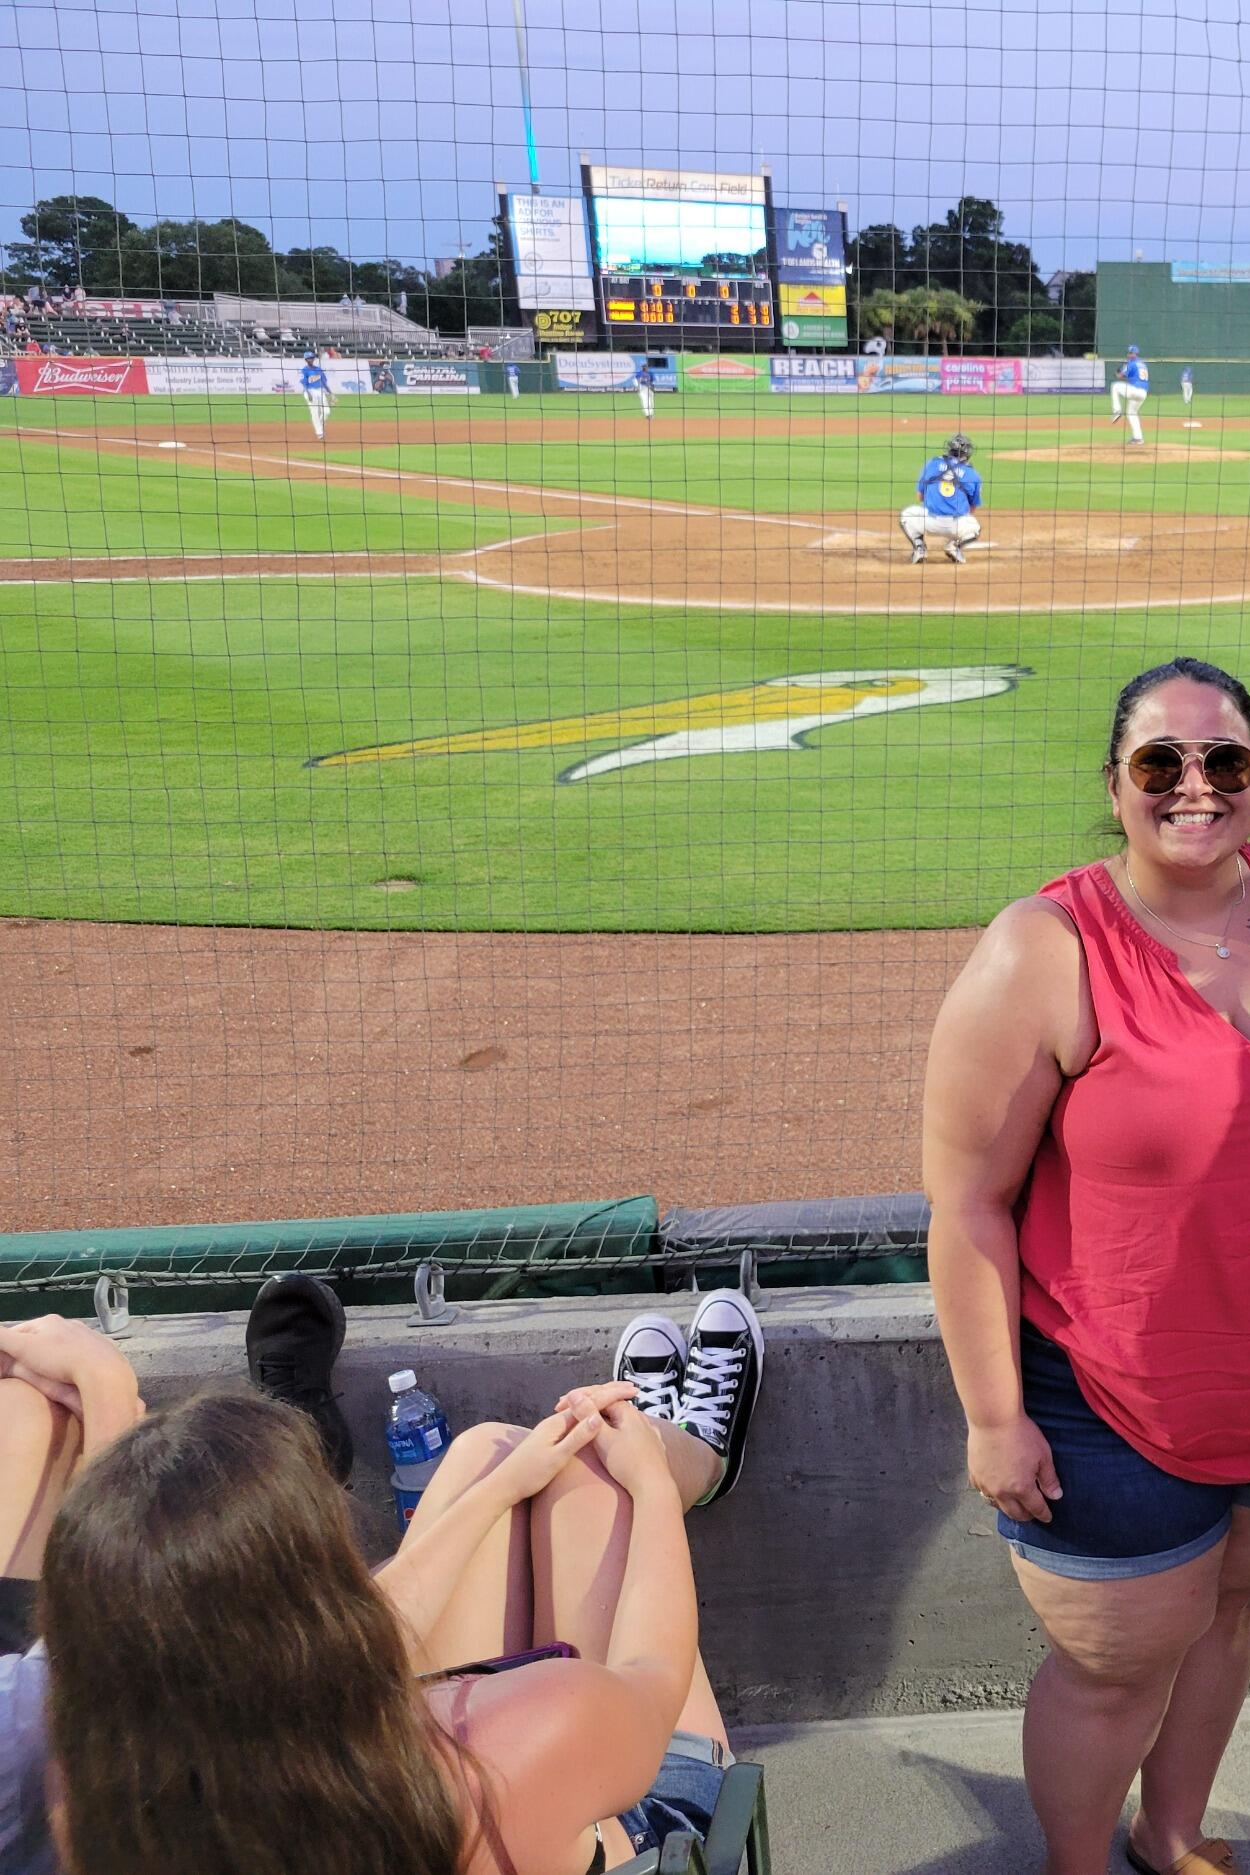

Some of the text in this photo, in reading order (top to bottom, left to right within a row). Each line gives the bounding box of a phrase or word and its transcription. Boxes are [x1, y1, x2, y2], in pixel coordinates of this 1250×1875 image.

[549, 311, 582, 323] 707
[558, 358, 633, 372] DocuSystems
[773, 358, 855, 376] REACH
[38, 367, 123, 383] Budweiser
[406, 373, 467, 385] CAROLINA
